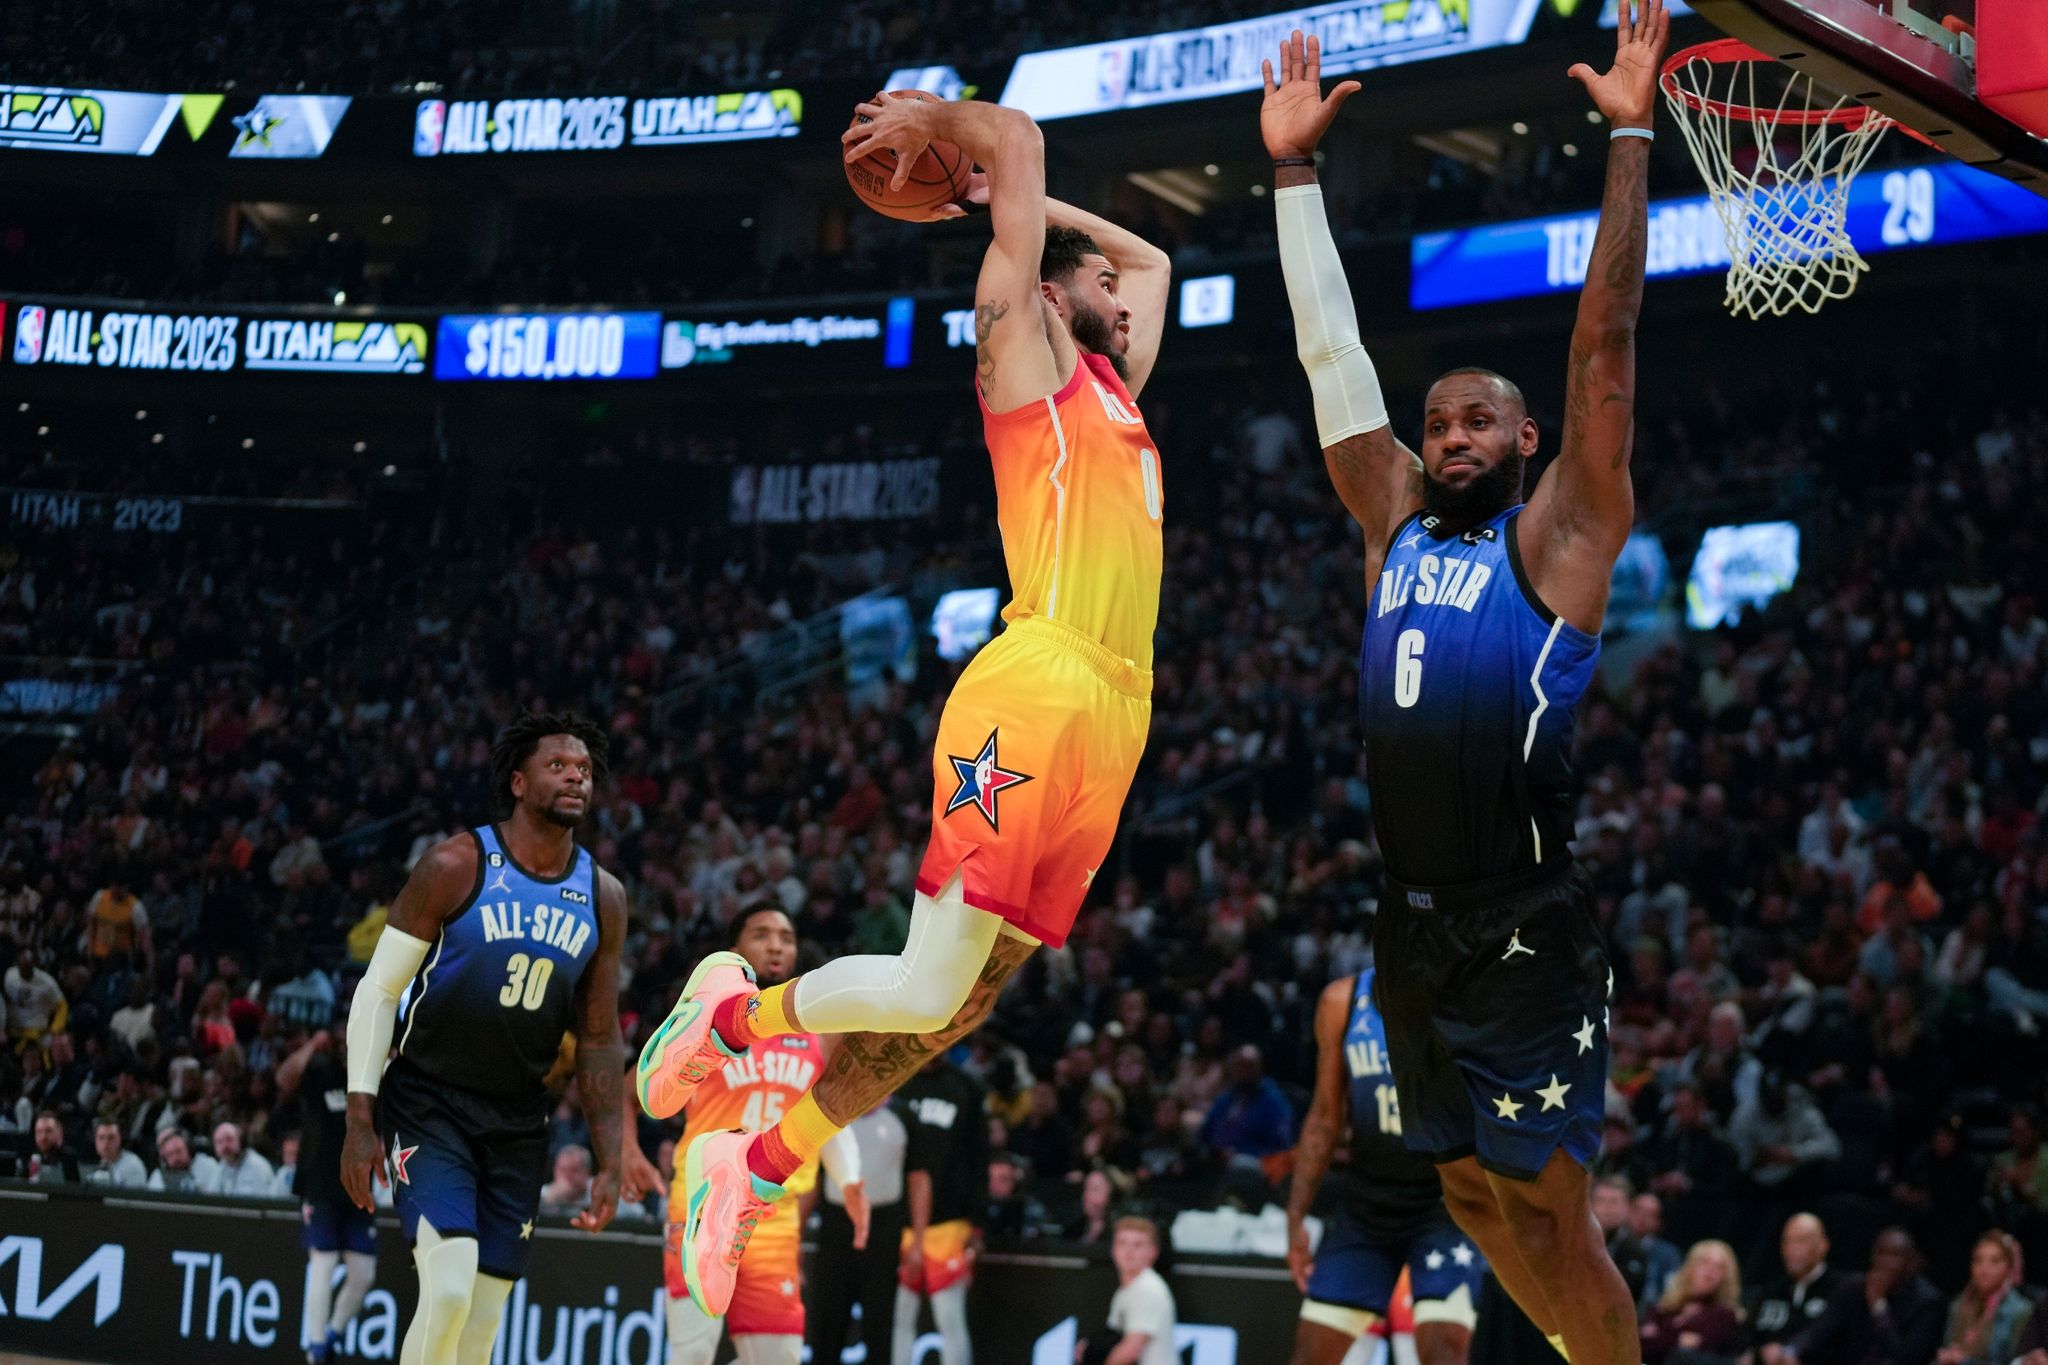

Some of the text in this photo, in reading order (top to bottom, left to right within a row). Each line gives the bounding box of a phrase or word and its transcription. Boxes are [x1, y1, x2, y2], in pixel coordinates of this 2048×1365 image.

[631, 95, 716, 136] UTAH
[1881, 168, 1935, 246] 29
[244, 320, 334, 360] UTAH
[465, 315, 625, 380] $150,000
[1090, 380, 1143, 425] ALL-
[1140, 448, 1160, 520] 0
[1394, 628, 1426, 708] 6
[499, 952, 554, 1011] 30
[1346, 1039, 1392, 1079] ALL-
[740, 1089, 786, 1132] 45
[172, 1249, 281, 1348] The
